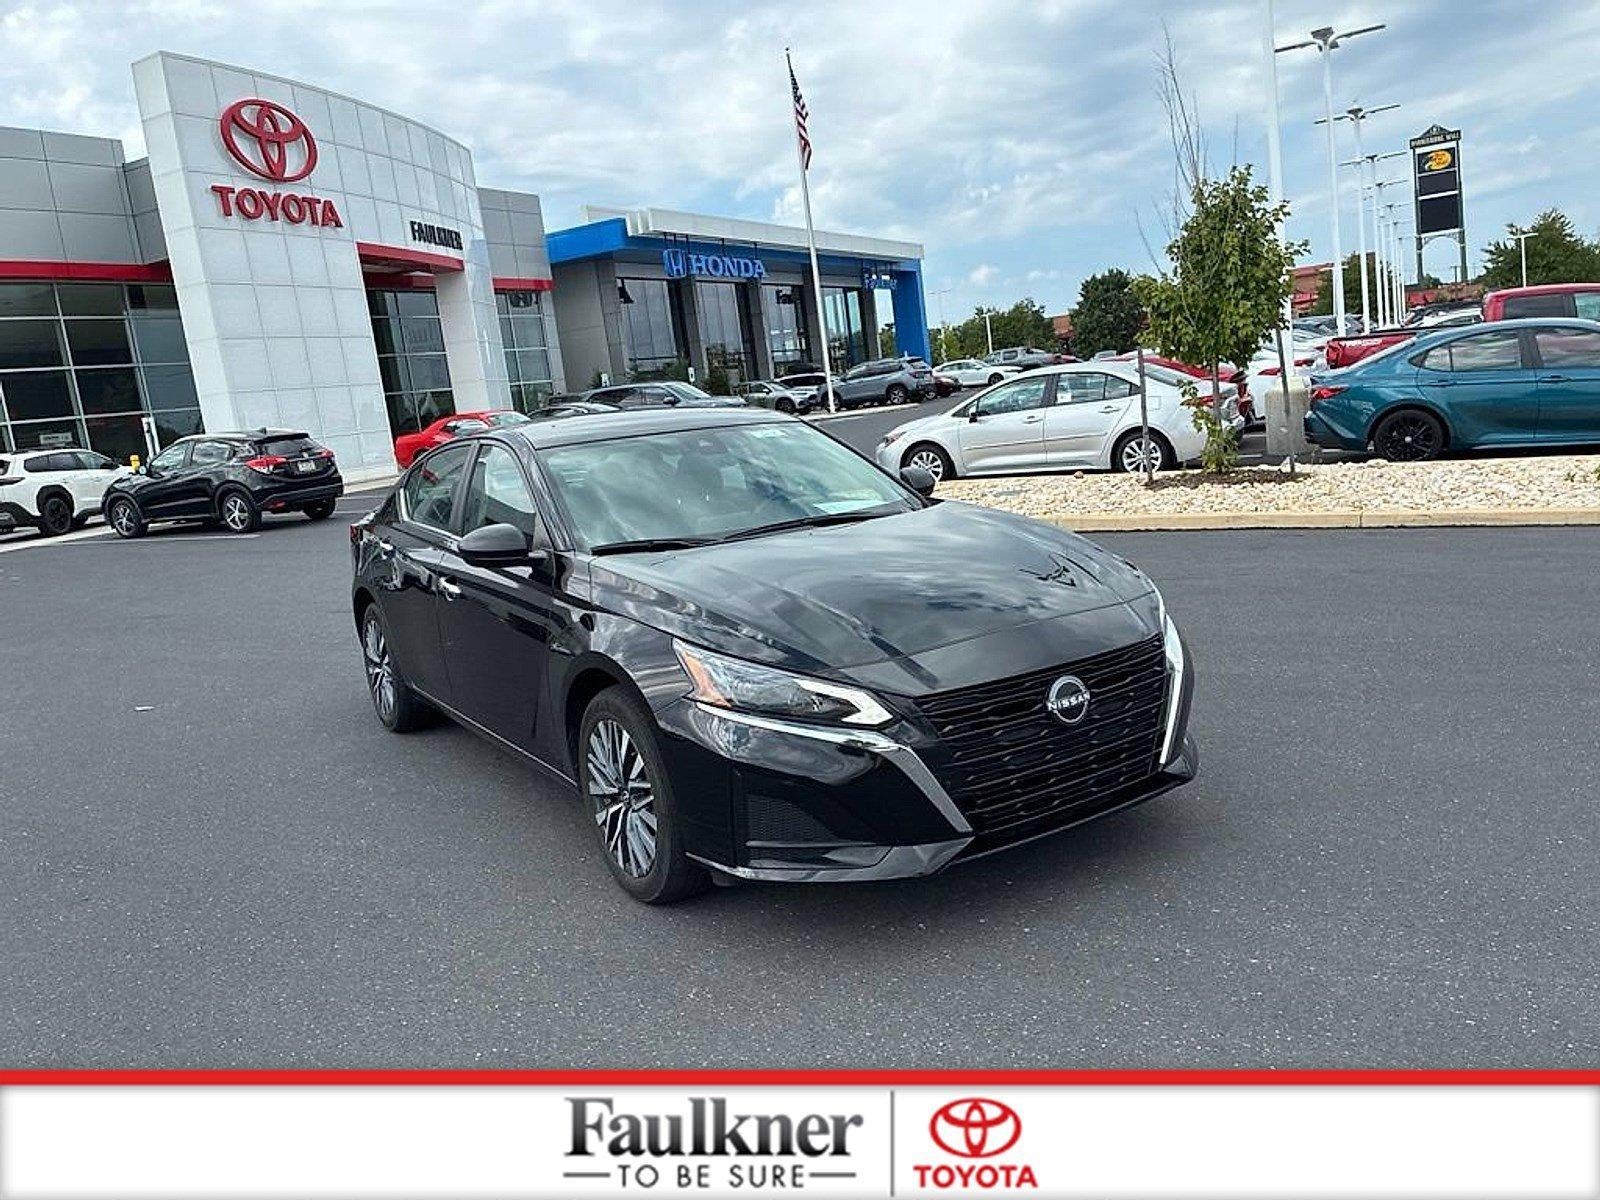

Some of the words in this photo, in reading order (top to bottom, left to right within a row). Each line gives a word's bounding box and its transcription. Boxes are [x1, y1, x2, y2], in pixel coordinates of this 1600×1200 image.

[211, 185, 343, 228] TOYOTA
[688, 254, 769, 278] HONDA
[1046, 690, 1090, 711] NISSAN
